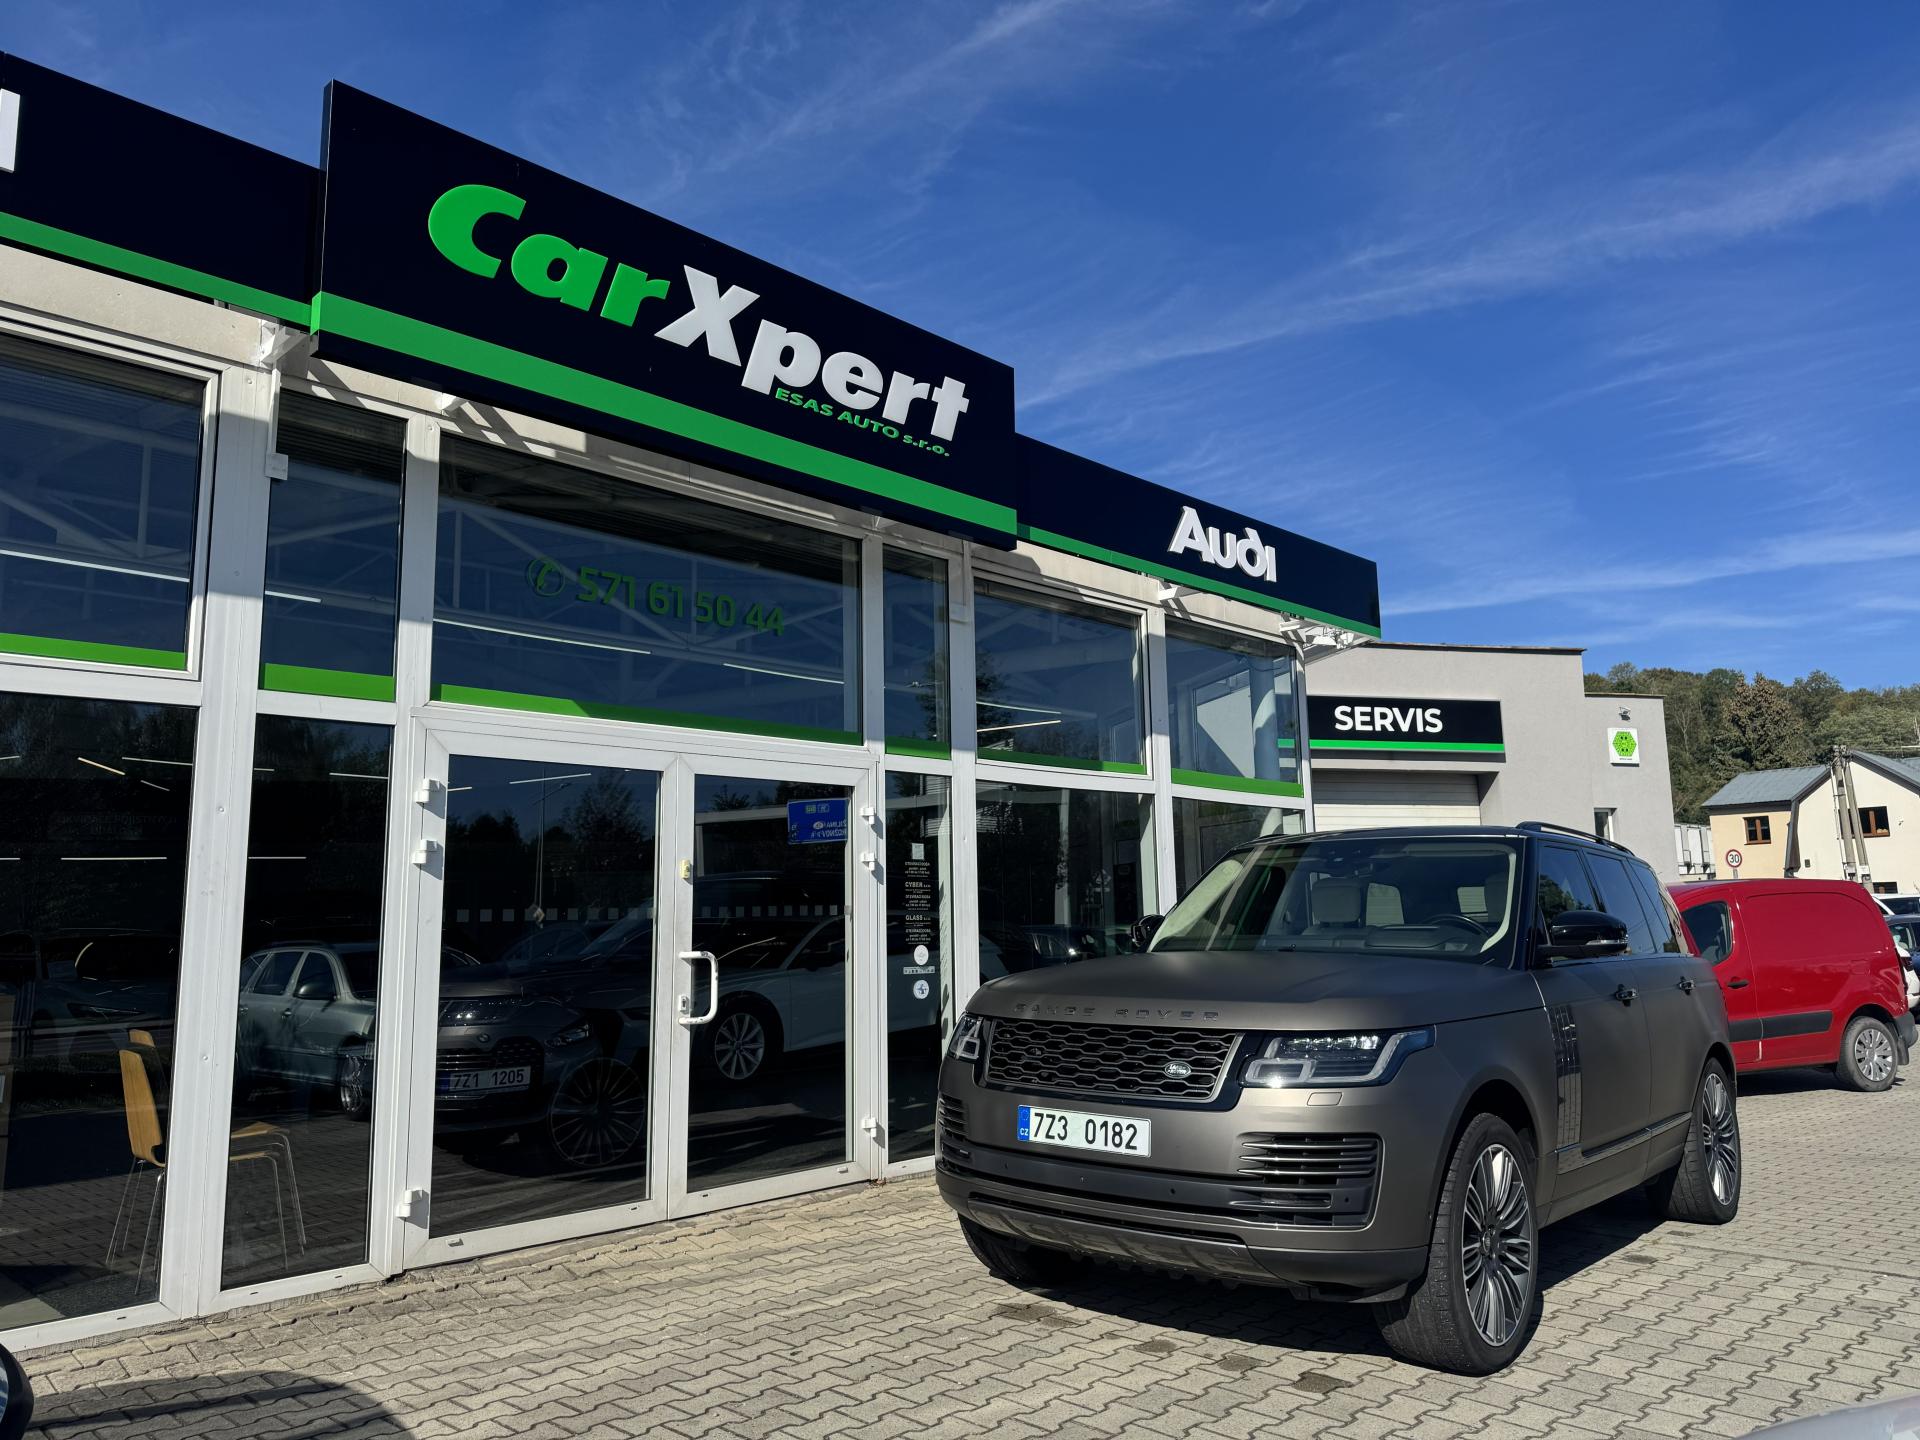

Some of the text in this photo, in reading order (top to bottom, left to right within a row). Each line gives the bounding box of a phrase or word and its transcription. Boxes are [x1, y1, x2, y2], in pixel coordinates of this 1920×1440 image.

[775, 387, 950, 457] ESAS AUTO s.r.o.
[1167, 505, 1277, 583] Audi
[577, 566, 785, 636] 571 61 50 44
[1334, 705, 1443, 733] SERVIS
[1729, 853, 1740, 863] 30
[1114, 1008, 1219, 1021] ROVER
[453, 1069, 525, 1089] 7Z1 1205
[1020, 1128, 1029, 1136] CZ
[1033, 1112, 1138, 1150] 7Z3 0182
